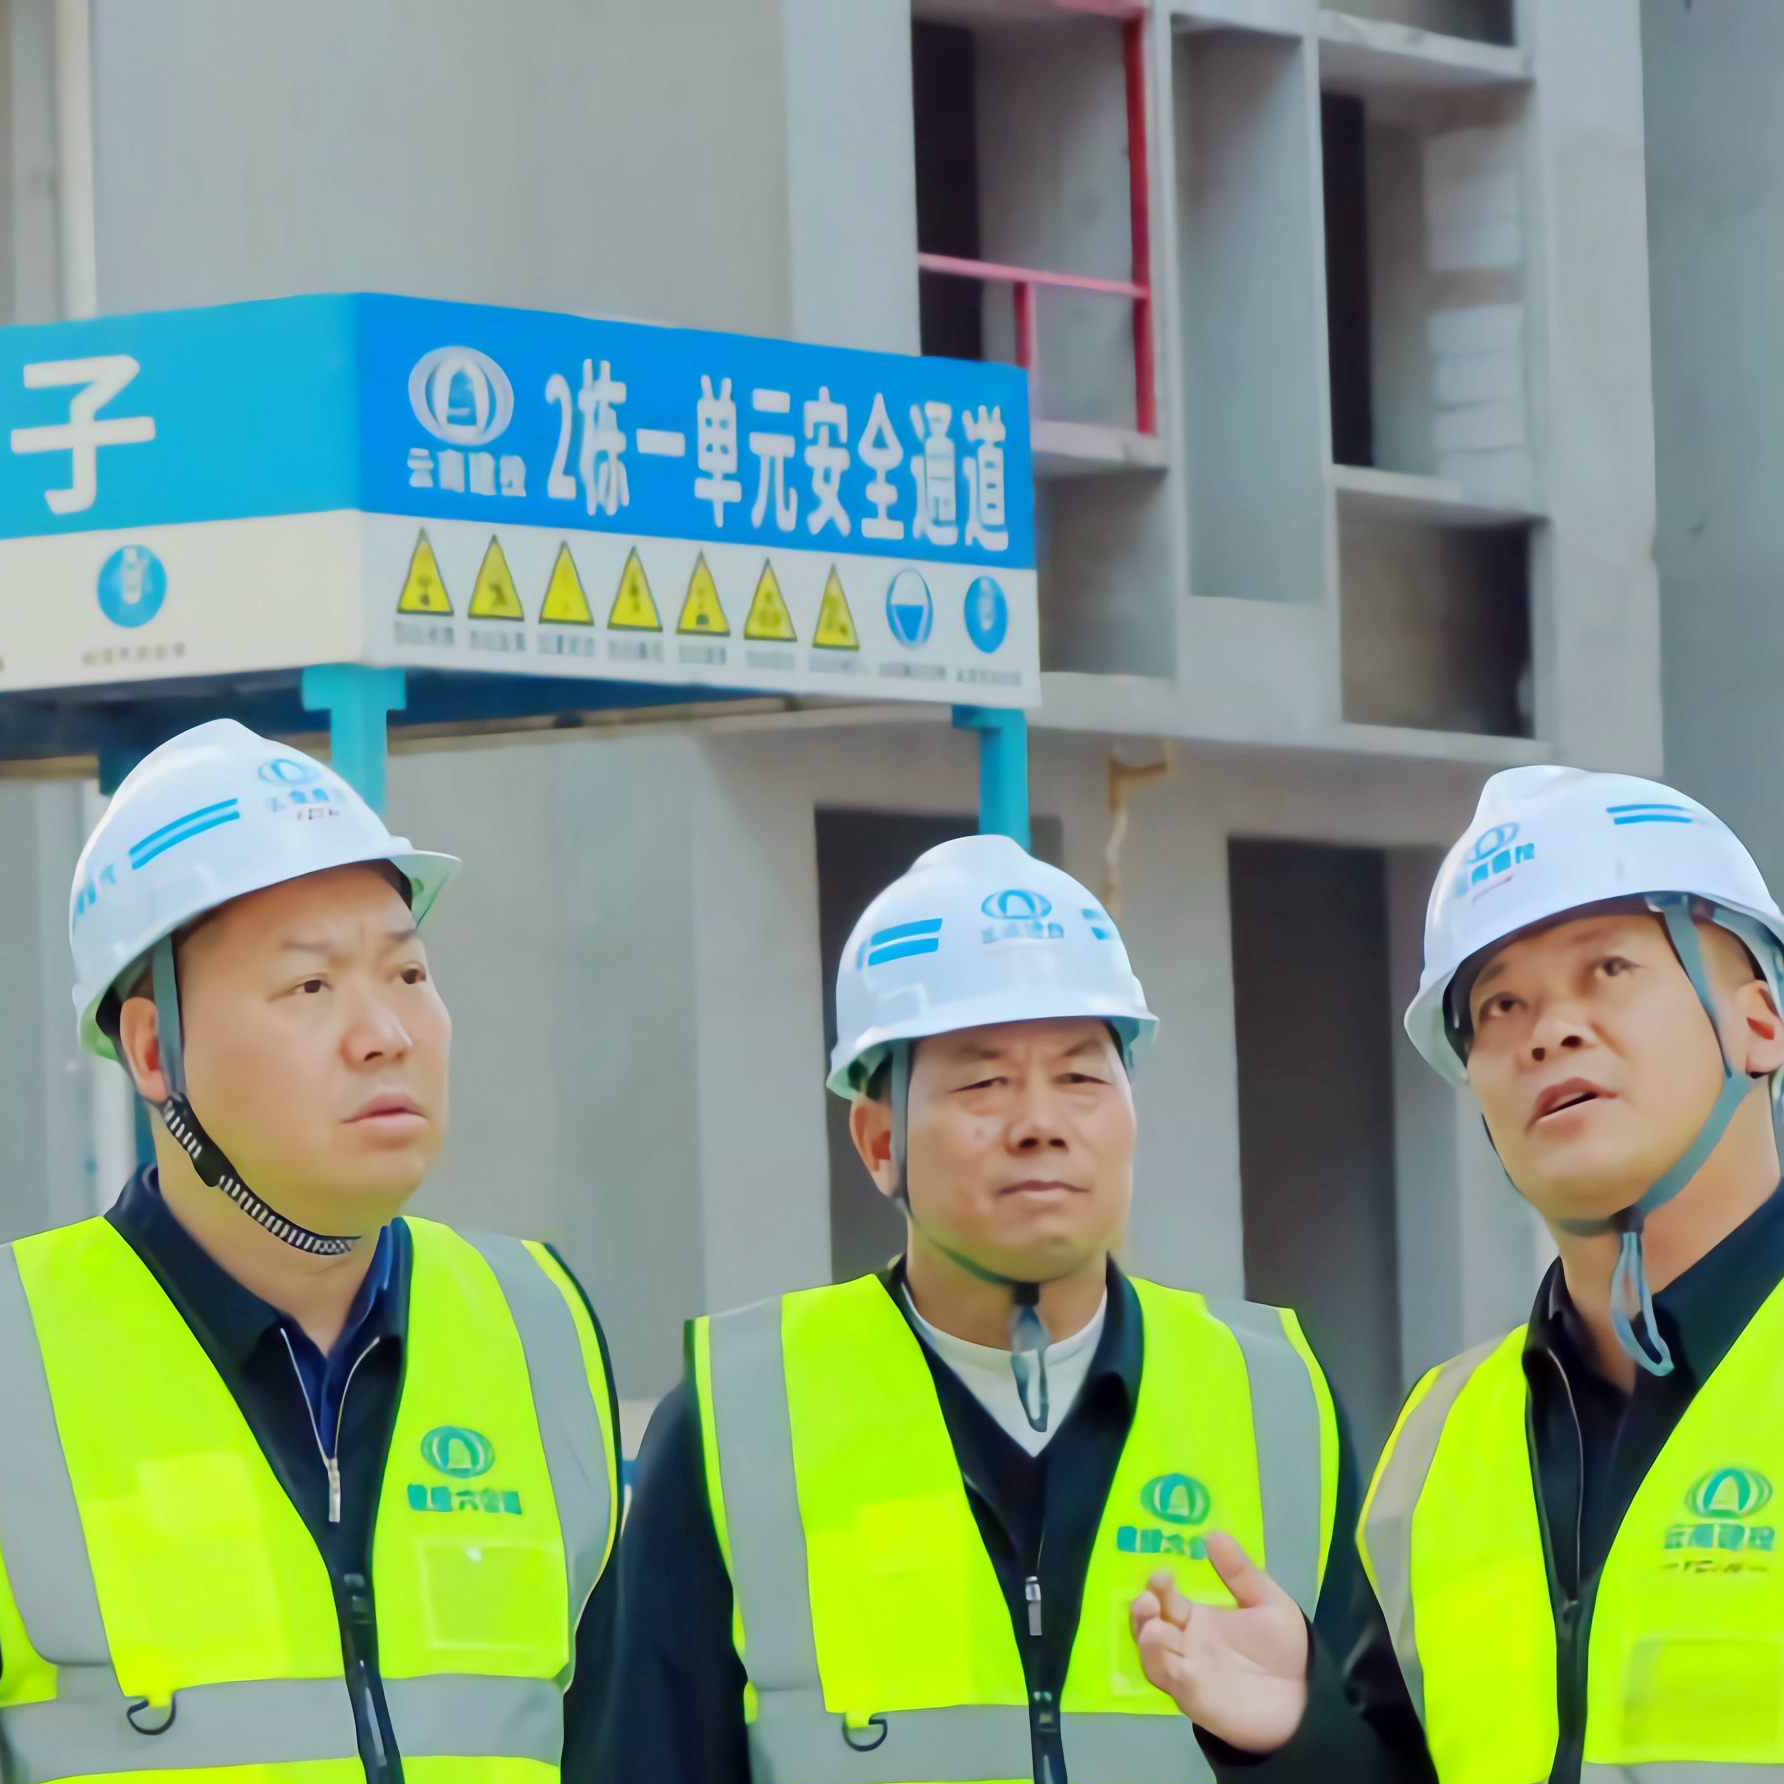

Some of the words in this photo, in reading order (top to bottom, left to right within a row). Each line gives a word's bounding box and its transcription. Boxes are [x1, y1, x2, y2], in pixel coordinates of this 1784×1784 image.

[544, 357, 1010, 552] 2栋一单元安全通道
